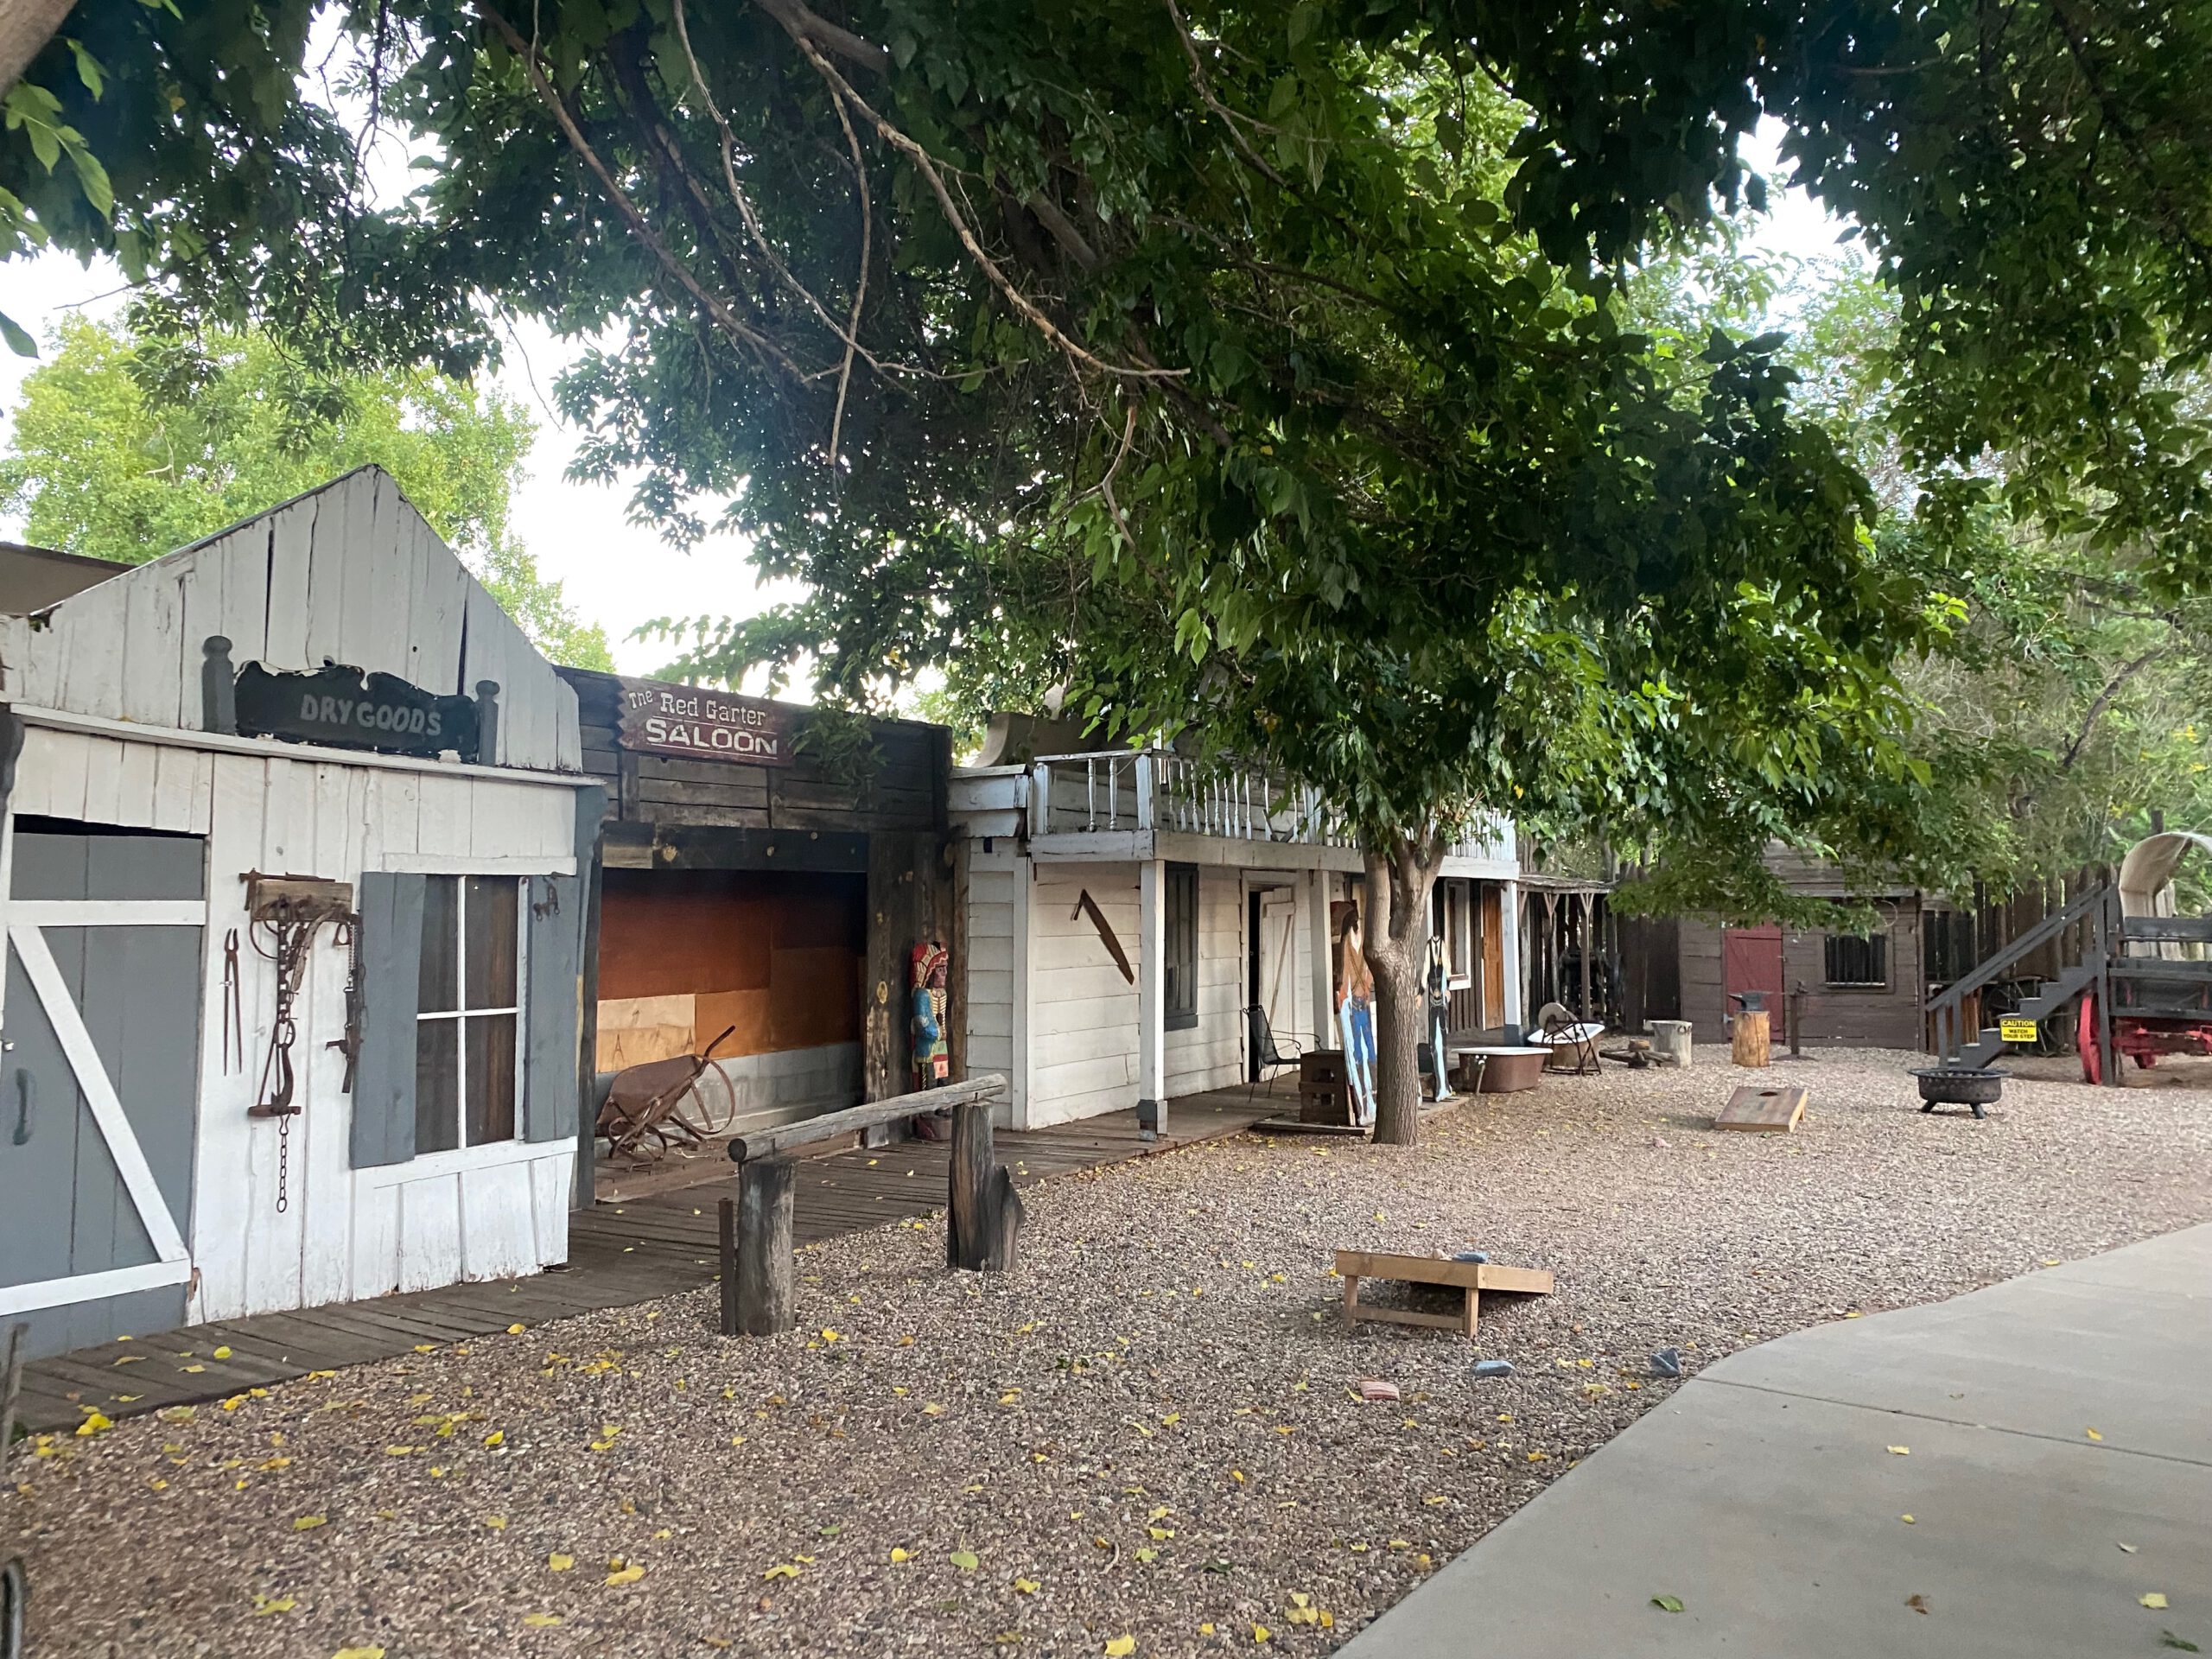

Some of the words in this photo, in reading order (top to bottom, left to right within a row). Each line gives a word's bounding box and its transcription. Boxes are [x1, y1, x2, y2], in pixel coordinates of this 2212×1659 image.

[301, 695, 353, 724] DRY
[356, 702, 442, 736] GOODS
[628, 690, 653, 709] The
[660, 692, 699, 717] Red
[706, 700, 766, 727] Garter
[645, 718, 778, 755] SALOON
